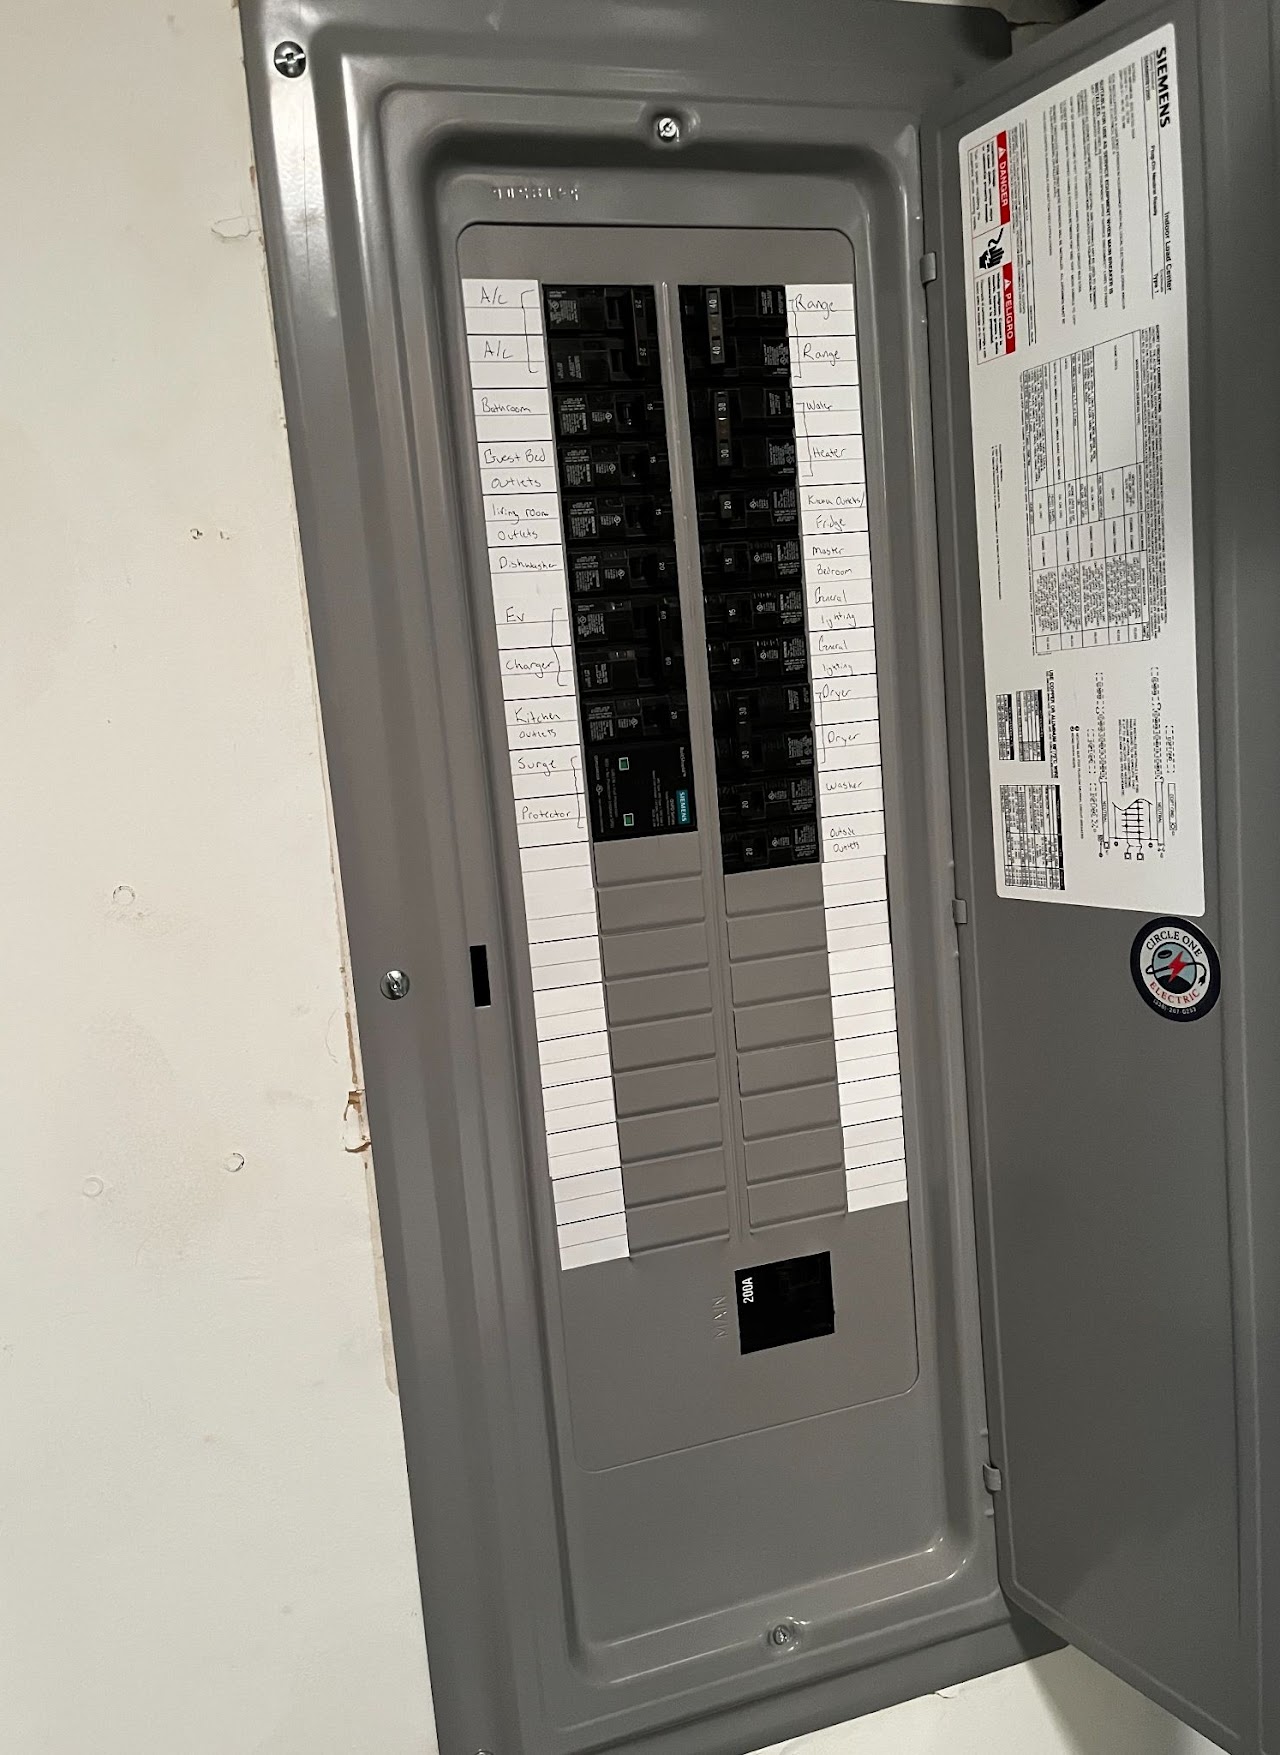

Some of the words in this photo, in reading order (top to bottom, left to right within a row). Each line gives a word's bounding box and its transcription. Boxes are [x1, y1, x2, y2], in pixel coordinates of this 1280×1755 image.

[1156, 47, 1170, 128] SIEMENS
[999, 160, 1008, 207] DANGER
[708, 300, 718, 308] 40
[795, 294, 838, 320] Range
[1005, 292, 1014, 340] PELIGRO
[712, 346, 721, 355] 40
[803, 342, 841, 366] Range
[481, 396, 532, 413] Bathroom
[718, 402, 726, 412] 30
[484, 448, 521, 464] Guest
[524, 448, 546, 463] Bed
[812, 447, 847, 458] Heater
[655, 508, 662, 516] 15
[724, 500, 732, 510] 20
[816, 514, 847, 532] Fridge
[812, 546, 845, 556] Master
[506, 659, 555, 678] Charger
[822, 683, 852, 702] Dryer
[514, 706, 561, 724] Kitchen
[828, 730, 861, 748] Dryer
[518, 757, 557, 777] Surge
[522, 806, 572, 820] Protector
[680, 792, 688, 822] SIEMENS
[742, 800, 749, 809] 20
[746, 848, 754, 856] 20
[1146, 930, 1180, 951] CIRCLE
[1182, 935, 1203, 957] ONE
[1149, 980, 1200, 1004] ELECTRIC
[742, 1276, 754, 1304] 200A
